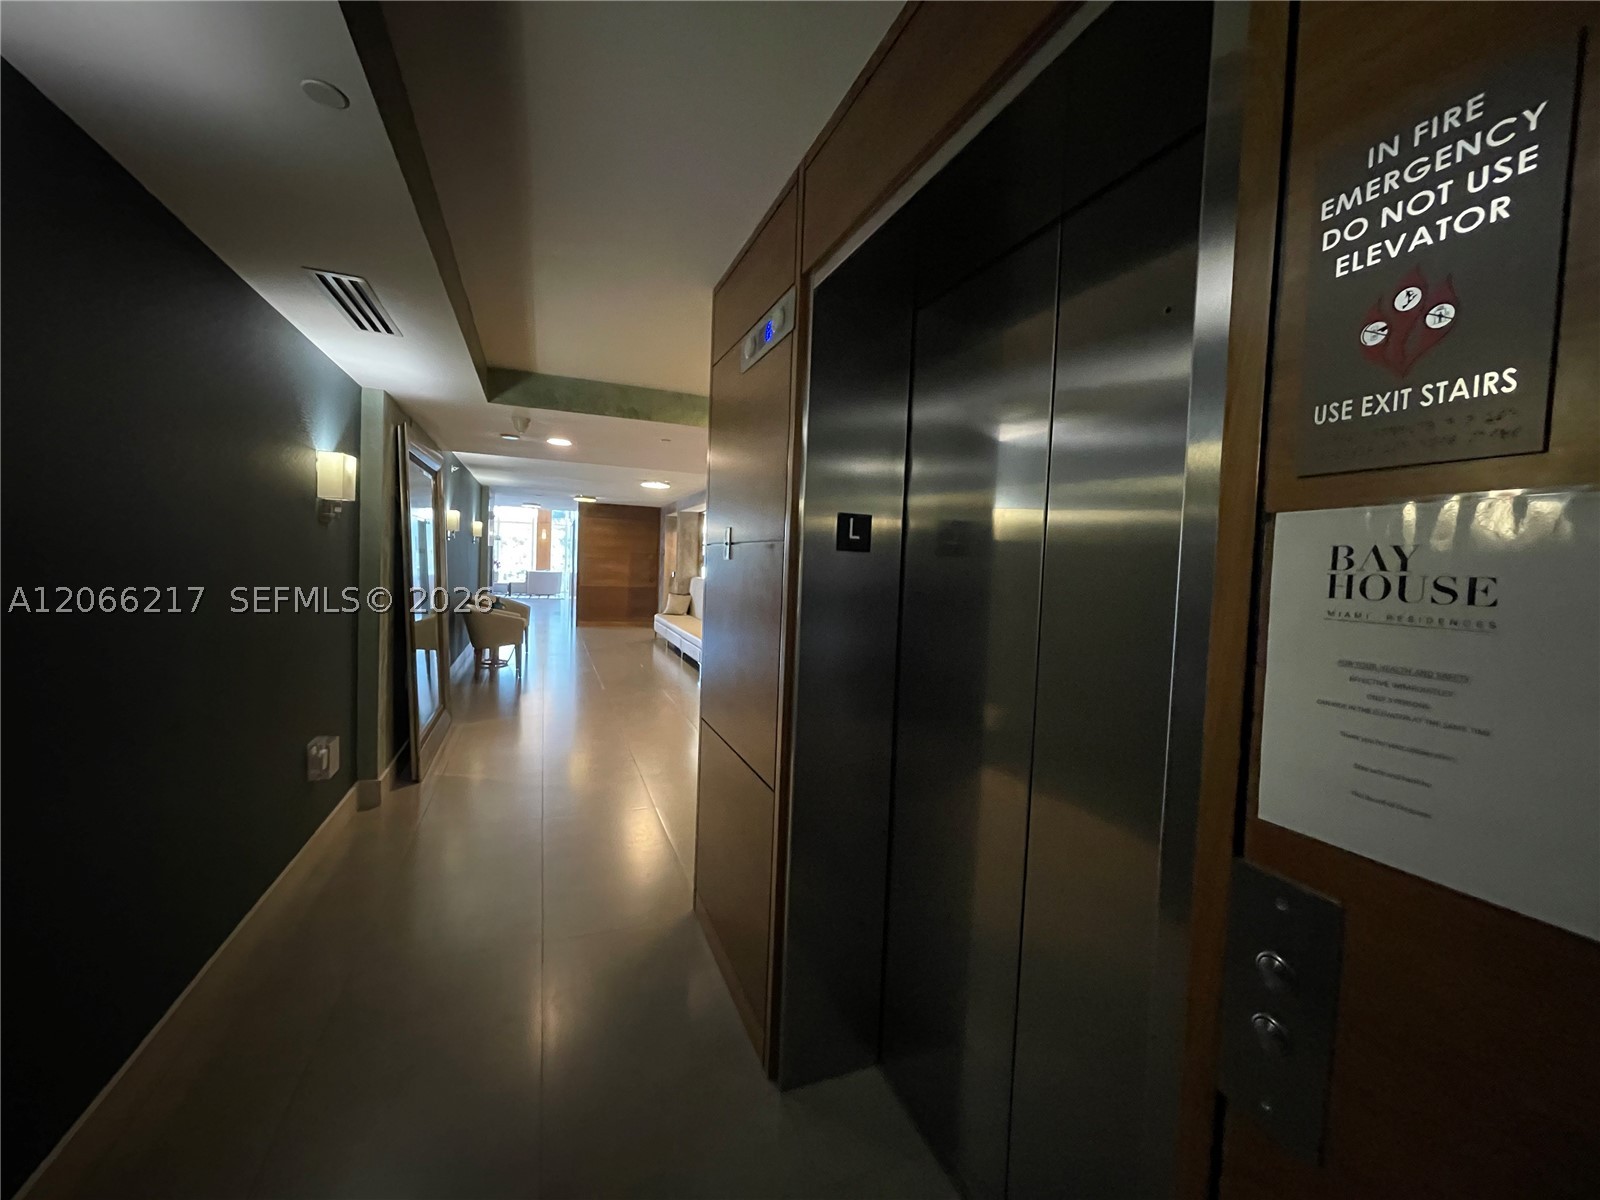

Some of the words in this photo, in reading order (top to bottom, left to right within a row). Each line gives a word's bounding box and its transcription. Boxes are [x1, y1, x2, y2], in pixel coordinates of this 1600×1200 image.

[1368, 134, 1399, 169] IN
[1413, 92, 1485, 147] FIRE
[1320, 100, 1548, 221] EMERGENCY
[1322, 217, 1368, 251] DO
[1380, 180, 1453, 228] NOT
[1467, 144, 1539, 193] USE
[1335, 195, 1511, 278] ELEVATOR
[1314, 399, 1353, 425] USE
[1361, 388, 1412, 417] EXIT
[1420, 367, 1518, 407] STAIRS
[850, 517, 860, 539] L
[1327, 544, 1420, 572] BAY
[1327, 573, 1498, 607] HOUSE
[1327, 610, 1370, 620] MIAMI
[1386, 614, 1497, 629] RESIDENCES
